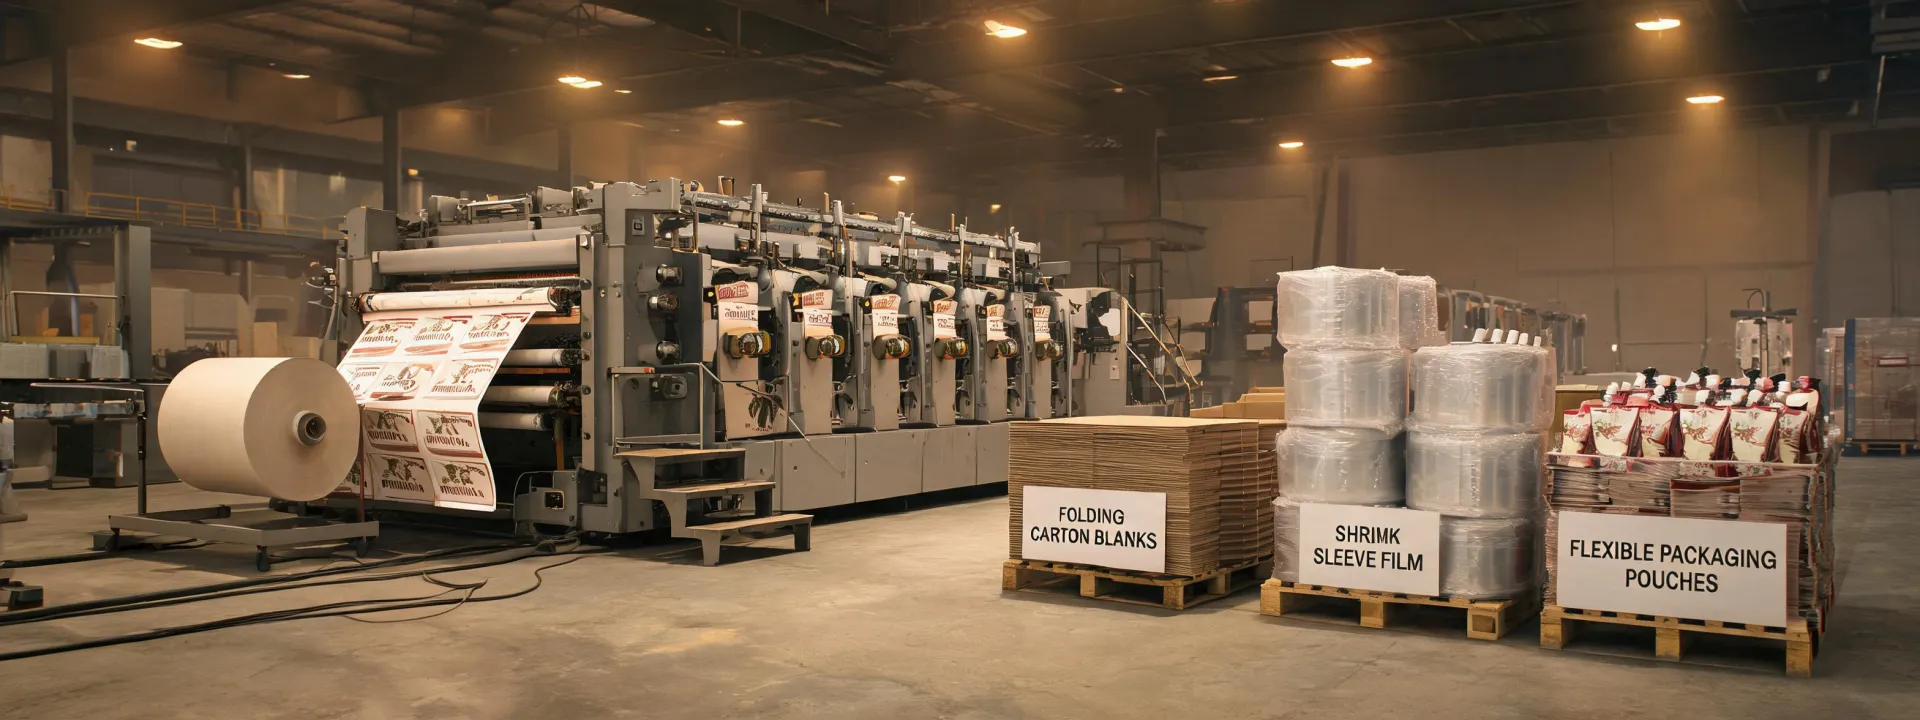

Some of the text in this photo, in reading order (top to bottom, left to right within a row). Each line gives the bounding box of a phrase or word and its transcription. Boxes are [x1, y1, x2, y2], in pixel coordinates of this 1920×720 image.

[1059, 506, 1125, 525] FOLDING
[1030, 526, 1157, 550] CARTON BLANKS
[1335, 524, 1401, 545] SHRIMK
[1313, 547, 1423, 572] SLEEVE FILM
[1570, 539, 1777, 569] FLEXIBLE PACKAGING
[1625, 568, 1719, 593] POUCHES
